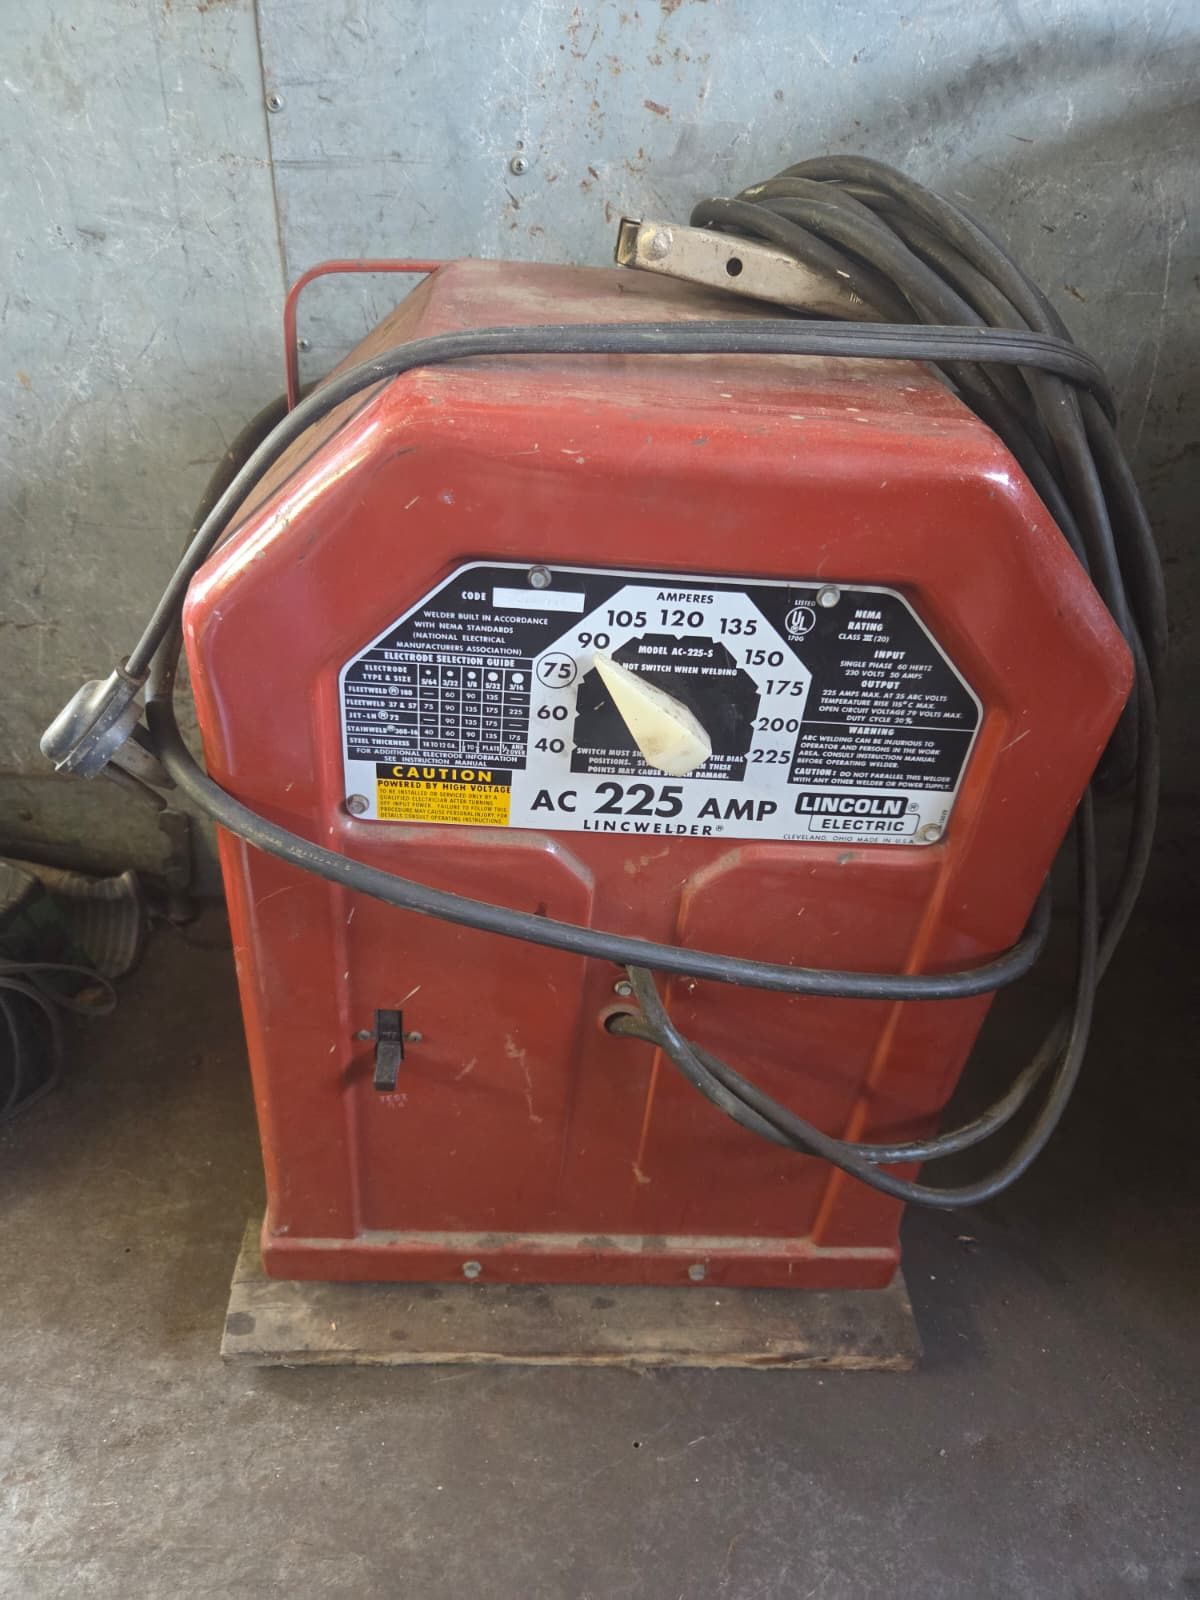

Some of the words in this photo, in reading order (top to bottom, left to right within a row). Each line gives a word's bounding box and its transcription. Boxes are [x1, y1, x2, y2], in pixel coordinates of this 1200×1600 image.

[462, 592, 486, 600] CODE
[657, 592, 714, 604] AMPERES
[424, 611, 455, 619] WELDER
[494, 616, 548, 625] ACCORDANCE
[855, 610, 882, 619] NEMA
[607, 610, 647, 627] 105
[661, 610, 704, 627] 120
[720, 618, 757, 635] 135
[848, 622, 883, 632] RATING
[467, 625, 513, 633] STANDARDS
[413, 632, 458, 641] (NATIONAL
[462, 635, 505, 643] ELECTRICAL
[578, 632, 610, 649] 90
[397, 642, 463, 652] MANUFACTURERS
[467, 646, 522, 656] ASSOCIATION)
[638, 646, 668, 654] MODEL
[672, 648, 713, 657] AC-225-S
[384, 652, 433, 662] ELECTRODE
[437, 656, 483, 666] SELECTION
[487, 659, 515, 667] GUIDE
[745, 650, 784, 667] 150
[874, 651, 906, 659] INPUT
[365, 664, 408, 673] ELECTRODE
[543, 662, 571, 679] 75
[641, 664, 671, 672] SWITCH
[674, 666, 698, 674] WHEN
[701, 668, 737, 676] WELDING
[362, 673, 382, 681] TYPE
[766, 680, 804, 696] 175
[861, 680, 900, 689] OUTPUT
[821, 698, 870, 706] TEMPERATURE
[537, 705, 568, 720] 60
[819, 705, 839, 713] OPEN
[871, 708, 904, 716] VOLTAGE
[758, 718, 799, 733] 200
[849, 727, 895, 735] WARNING
[820, 735, 853, 743] WELDING
[534, 738, 565, 754] 40
[859, 745, 890, 753] PERSONS
[589, 757, 631, 765] POSITIONS.
[752, 750, 790, 764] 225
[856, 753, 902, 761] INSTRUCTION
[904, 755, 936, 763] MANUAL
[826, 759, 866, 767] OPERATING
[392, 766, 492, 782] CAUTION
[794, 768, 837, 776] CAUTION:
[378, 781, 421, 789] POWERED
[442, 783, 466, 791] HIGH
[471, 785, 511, 793] VOLTAGE
[530, 790, 577, 812] AC
[594, 782, 683, 818] 225
[697, 798, 777, 821] AMP
[801, 797, 901, 815] LINCOLN
[822, 819, 904, 831] ELECTRIC
